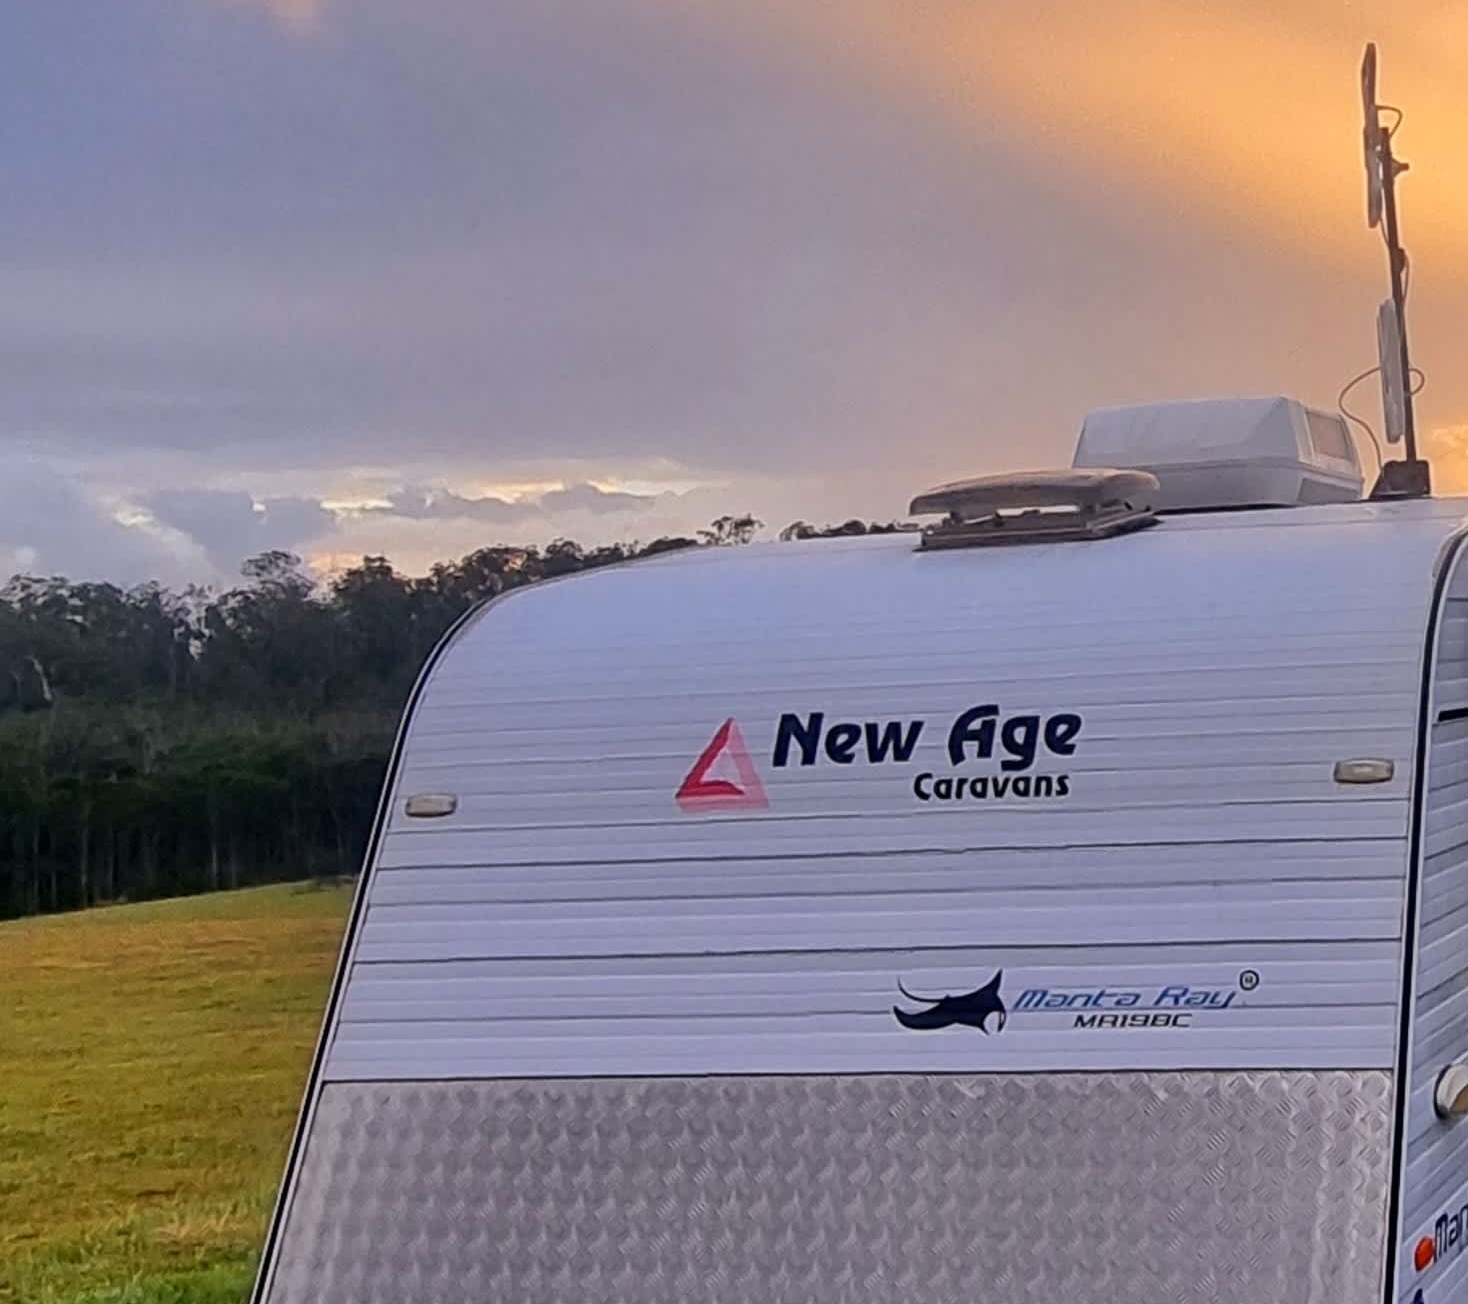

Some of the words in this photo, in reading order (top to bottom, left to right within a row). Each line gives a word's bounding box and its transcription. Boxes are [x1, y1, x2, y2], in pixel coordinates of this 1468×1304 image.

[772, 711, 924, 768] New
[947, 703, 1082, 771] Age
[913, 772, 1070, 801] Caravans
[1012, 988, 1142, 1011] Manta
[1154, 985, 1236, 1009] Ray
